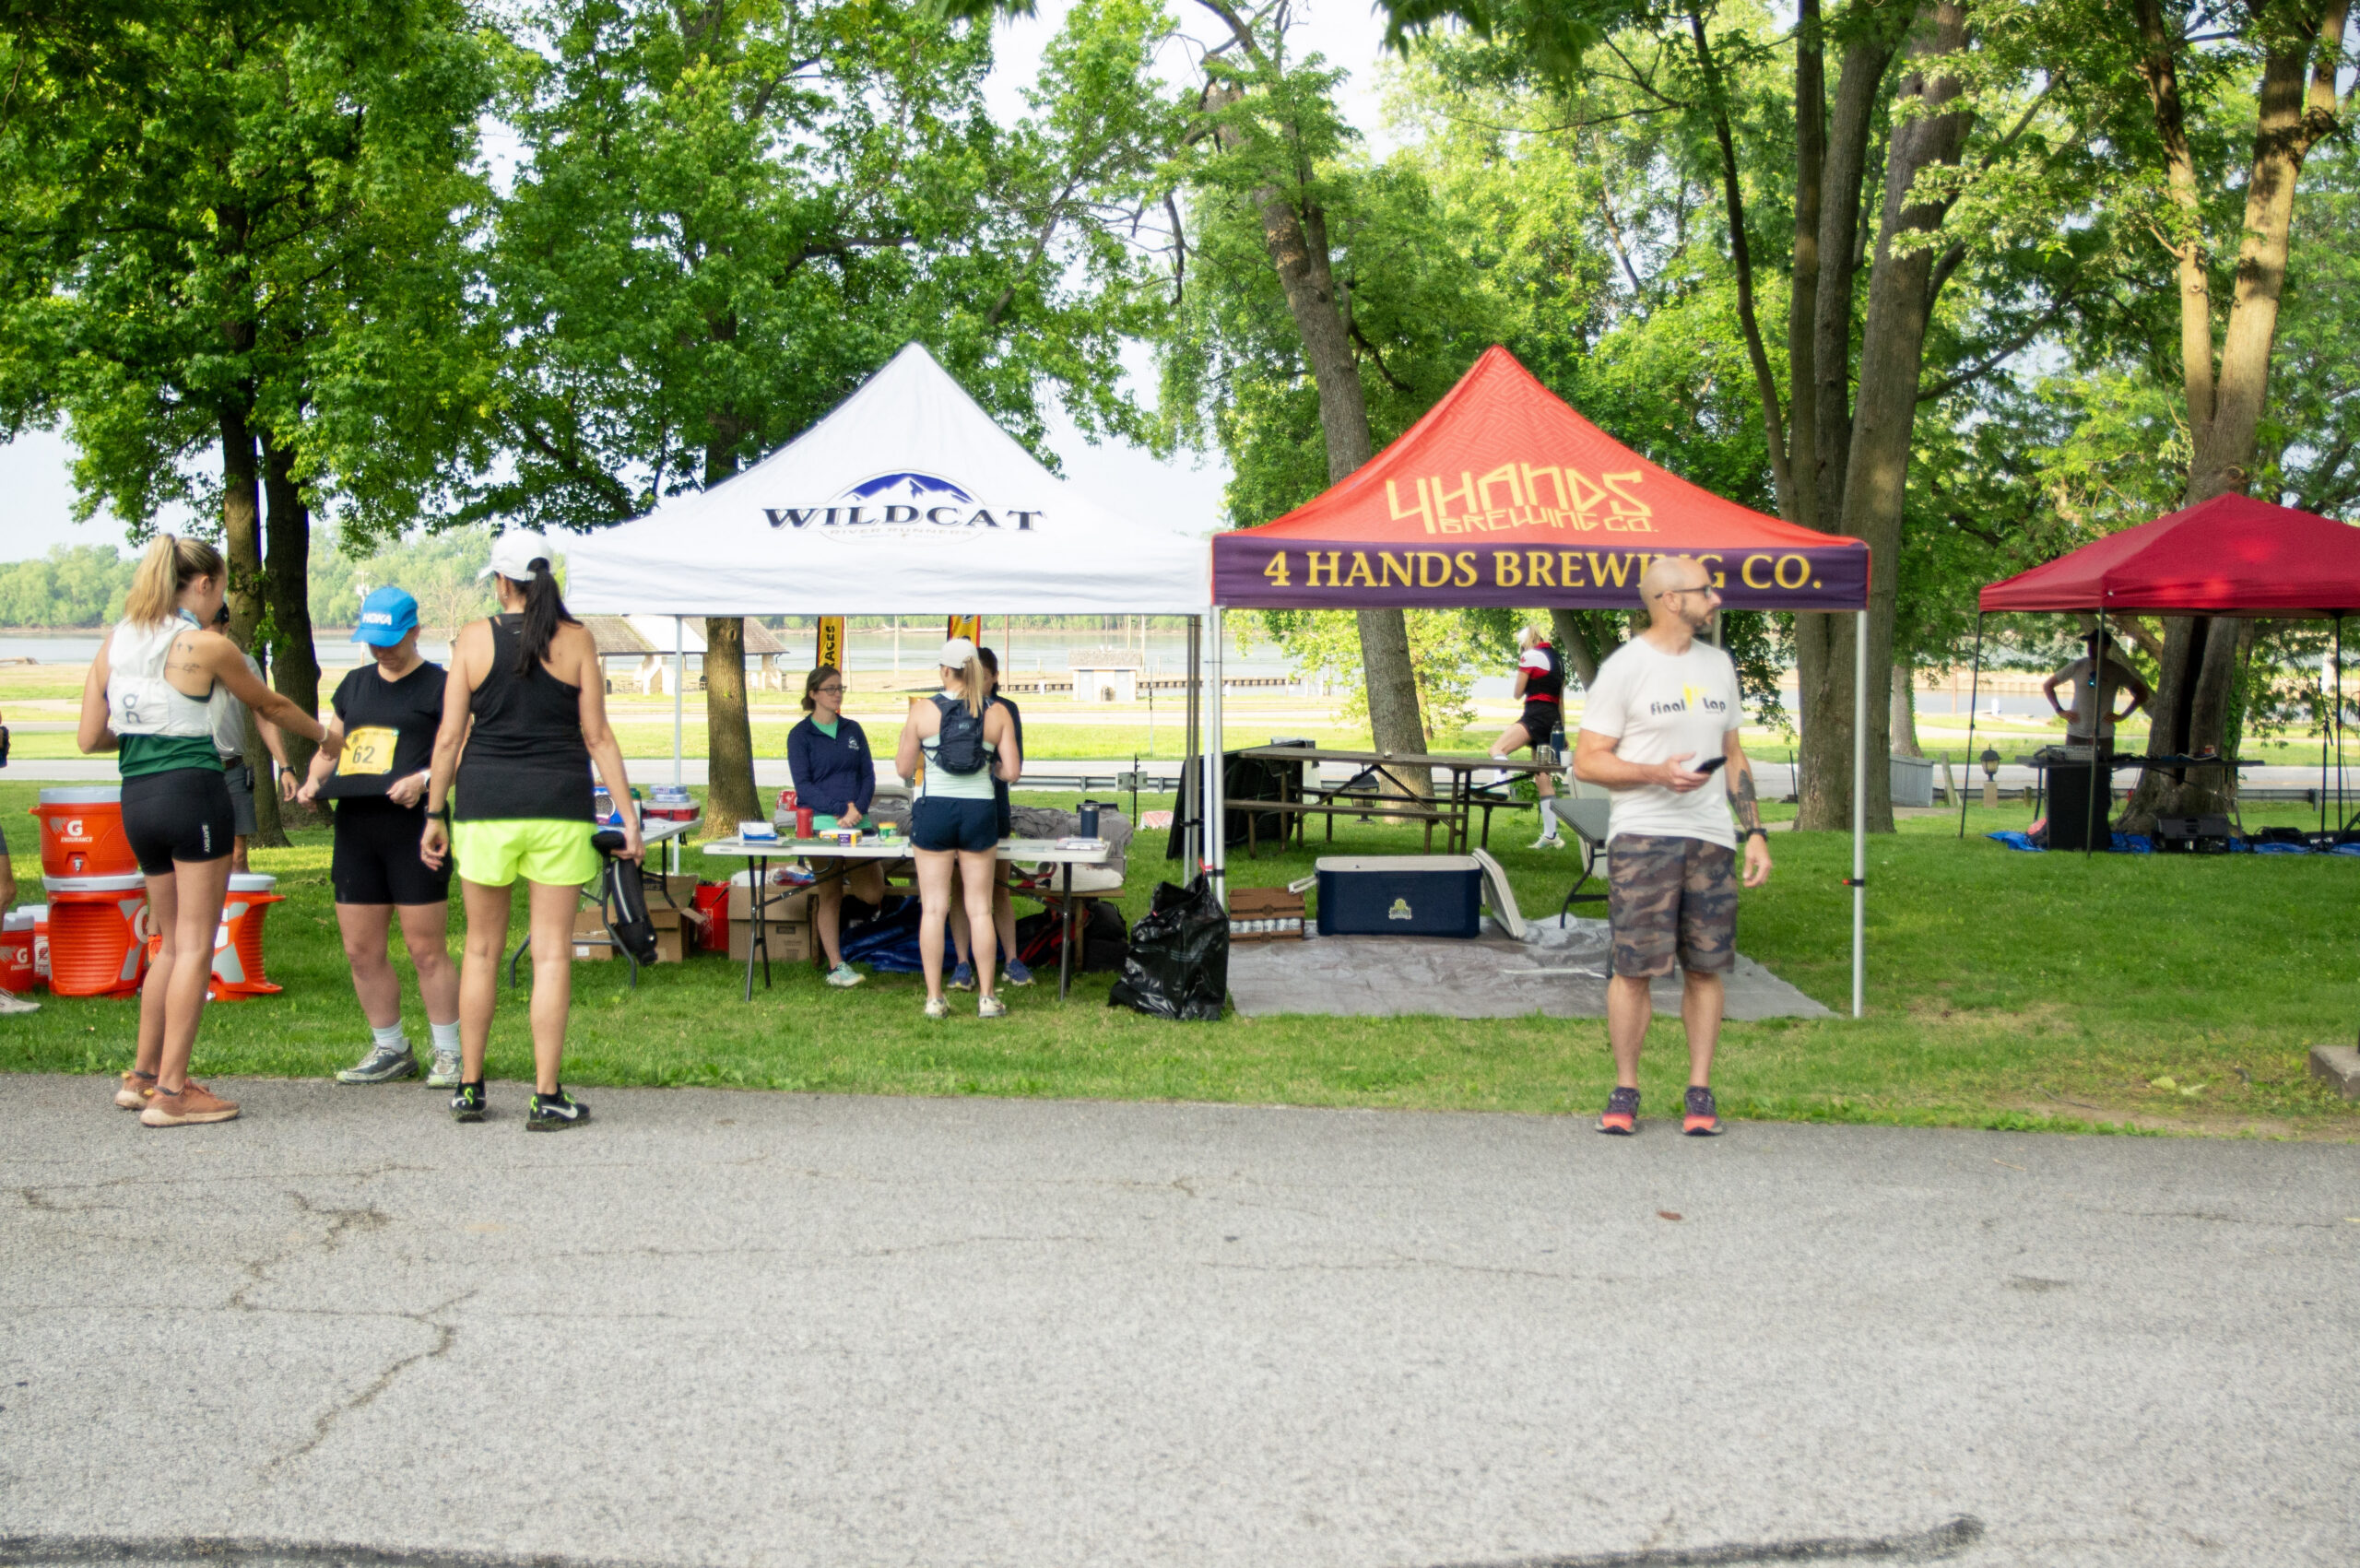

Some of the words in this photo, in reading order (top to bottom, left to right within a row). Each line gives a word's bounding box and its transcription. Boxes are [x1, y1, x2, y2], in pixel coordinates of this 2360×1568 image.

[761, 504, 1047, 532] WILDCAT
[1439, 505, 1599, 535] BREWING
[1263, 551, 1291, 586] 4
[1305, 551, 1478, 588] HANDS
[1492, 551, 1726, 589] BREWIG
[1740, 554, 1823, 590] CO.
[361, 612, 393, 626] HOKA
[352, 745, 376, 764] 62
[66, 819, 84, 837] G
[201, 824, 211, 854] SAYSKY
[16, 947, 29, 964] G
